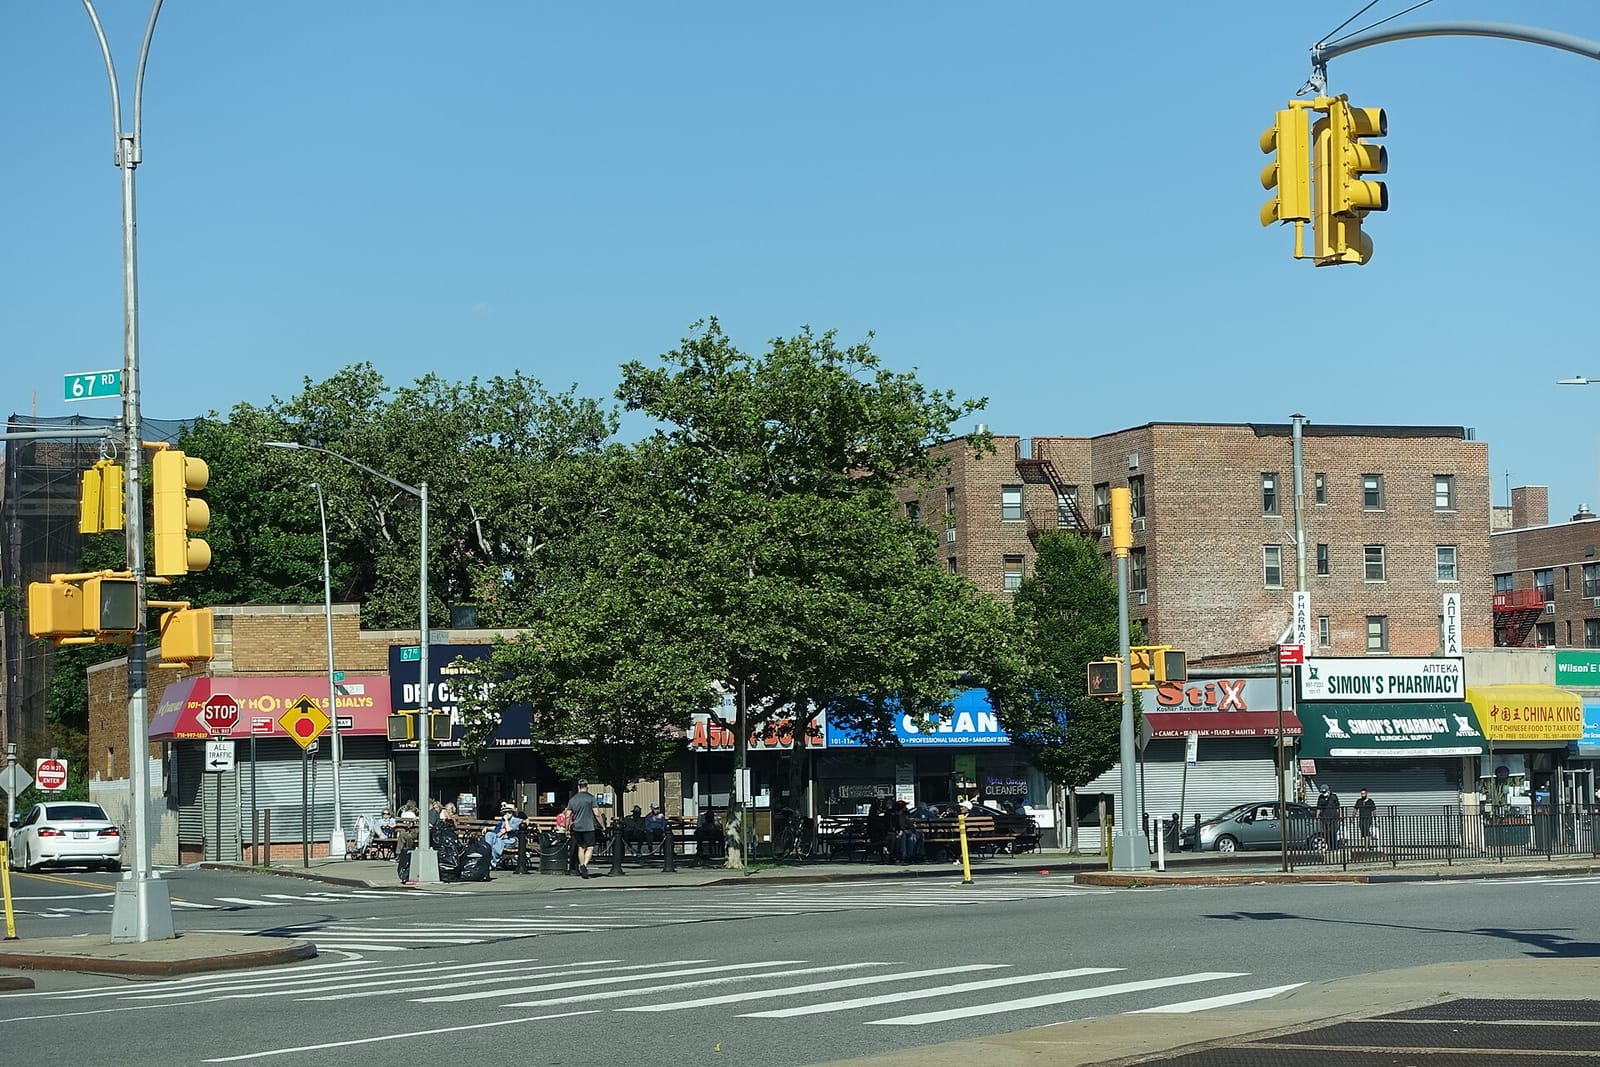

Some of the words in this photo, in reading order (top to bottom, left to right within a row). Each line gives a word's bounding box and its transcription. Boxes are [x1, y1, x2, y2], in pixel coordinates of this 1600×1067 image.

[72, 375, 96, 397] 67
[101, 374, 115, 385] RD
[1298, 594, 1306, 648] PHARMAC
[1447, 596, 1457, 653] АПТЕКА
[402, 649, 413, 659] 67
[1422, 664, 1459, 673] АПТЕКА
[1327, 675, 1384, 694] SIMON'S
[1388, 675, 1459, 694] PHARMACY
[335, 697, 374, 708] BIALYS
[205, 705, 237, 720] STOP
[1523, 706, 1554, 722] CHINA
[1556, 706, 1581, 722] KING
[1347, 718, 1394, 735] SIMON'S
[1392, 717, 1450, 734] PHARMACY
[985, 785, 1028, 795] CLEANERS
